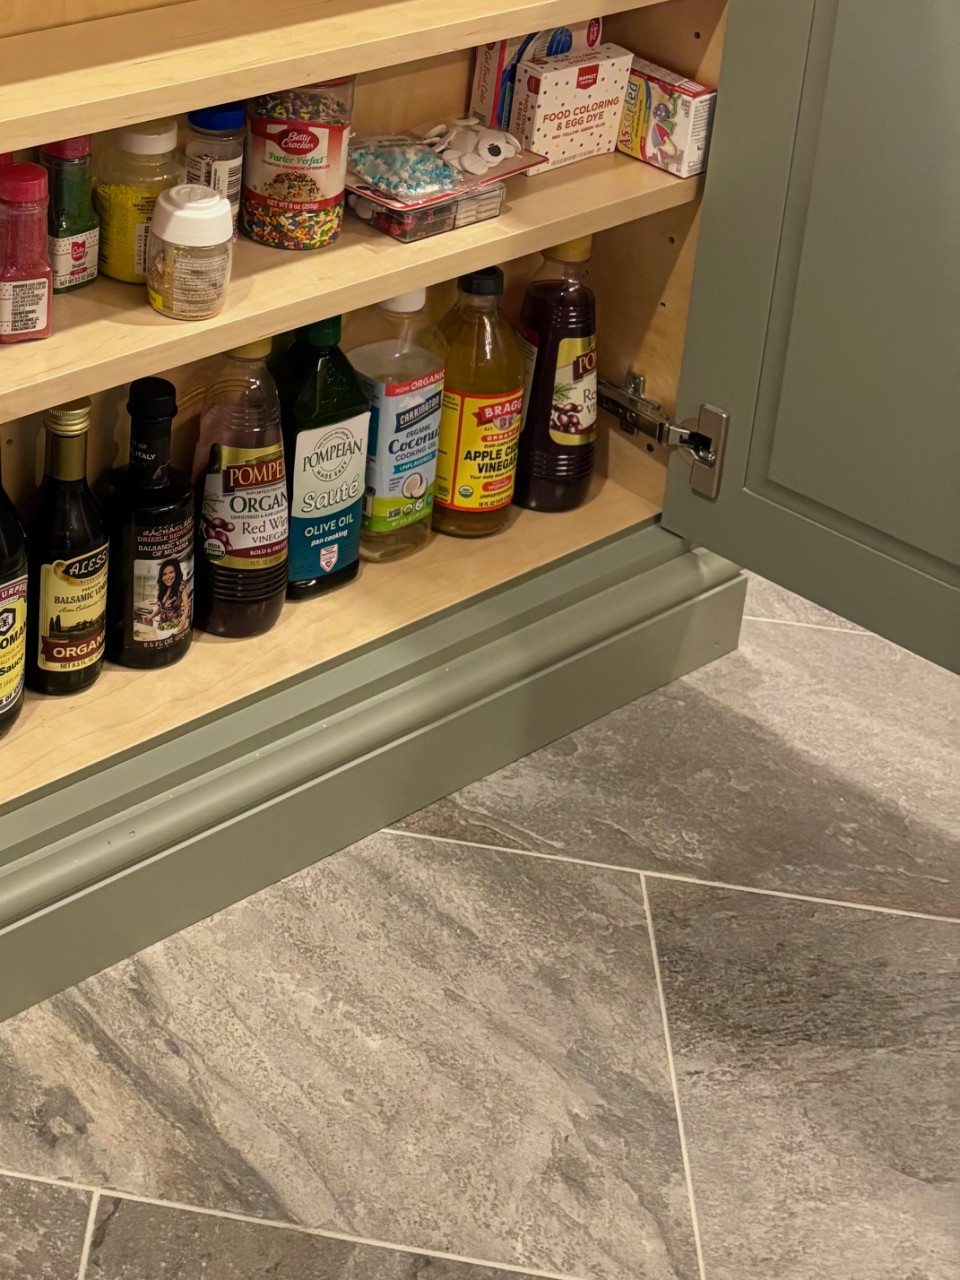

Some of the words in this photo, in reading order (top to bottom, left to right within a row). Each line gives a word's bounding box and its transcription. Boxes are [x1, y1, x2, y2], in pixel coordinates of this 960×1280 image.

[542, 110, 571, 124] FOOD
[572, 96, 620, 115] COLORING
[619, 80, 639, 150] Assorted
[556, 122, 563, 131] &
[564, 117, 585, 129] EGG
[586, 111, 605, 124] DYE
[281, 138, 314, 149] Crocker
[288, 131, 312, 142] Betty
[395, 385, 410, 395] NOW
[410, 369, 446, 391] ORGANIC
[399, 394, 441, 425] CARRINGTON
[405, 423, 433, 439] ORGANIC
[302, 438, 363, 473] POMPEIAN
[394, 447, 427, 462] COOKING
[427, 441, 438, 453] OIL
[464, 448, 503, 462] APPLE
[316, 469, 333, 480] MADE
[334, 460, 348, 477] EASY
[399, 453, 433, 472] UNFLAVORED
[301, 473, 360, 513] Sauté
[241, 520, 266, 535] Red
[304, 519, 337, 537] OLIVE
[338, 512, 355, 528] OIL
[138, 542, 175, 552] BALSAMIC
[310, 536, 324, 548] pan
[324, 528, 348, 544] cooking
[249, 549, 267, 557] BOLD
[54, 590, 95, 605] BALSAMIC
[5, 691, 13, 702] OF
